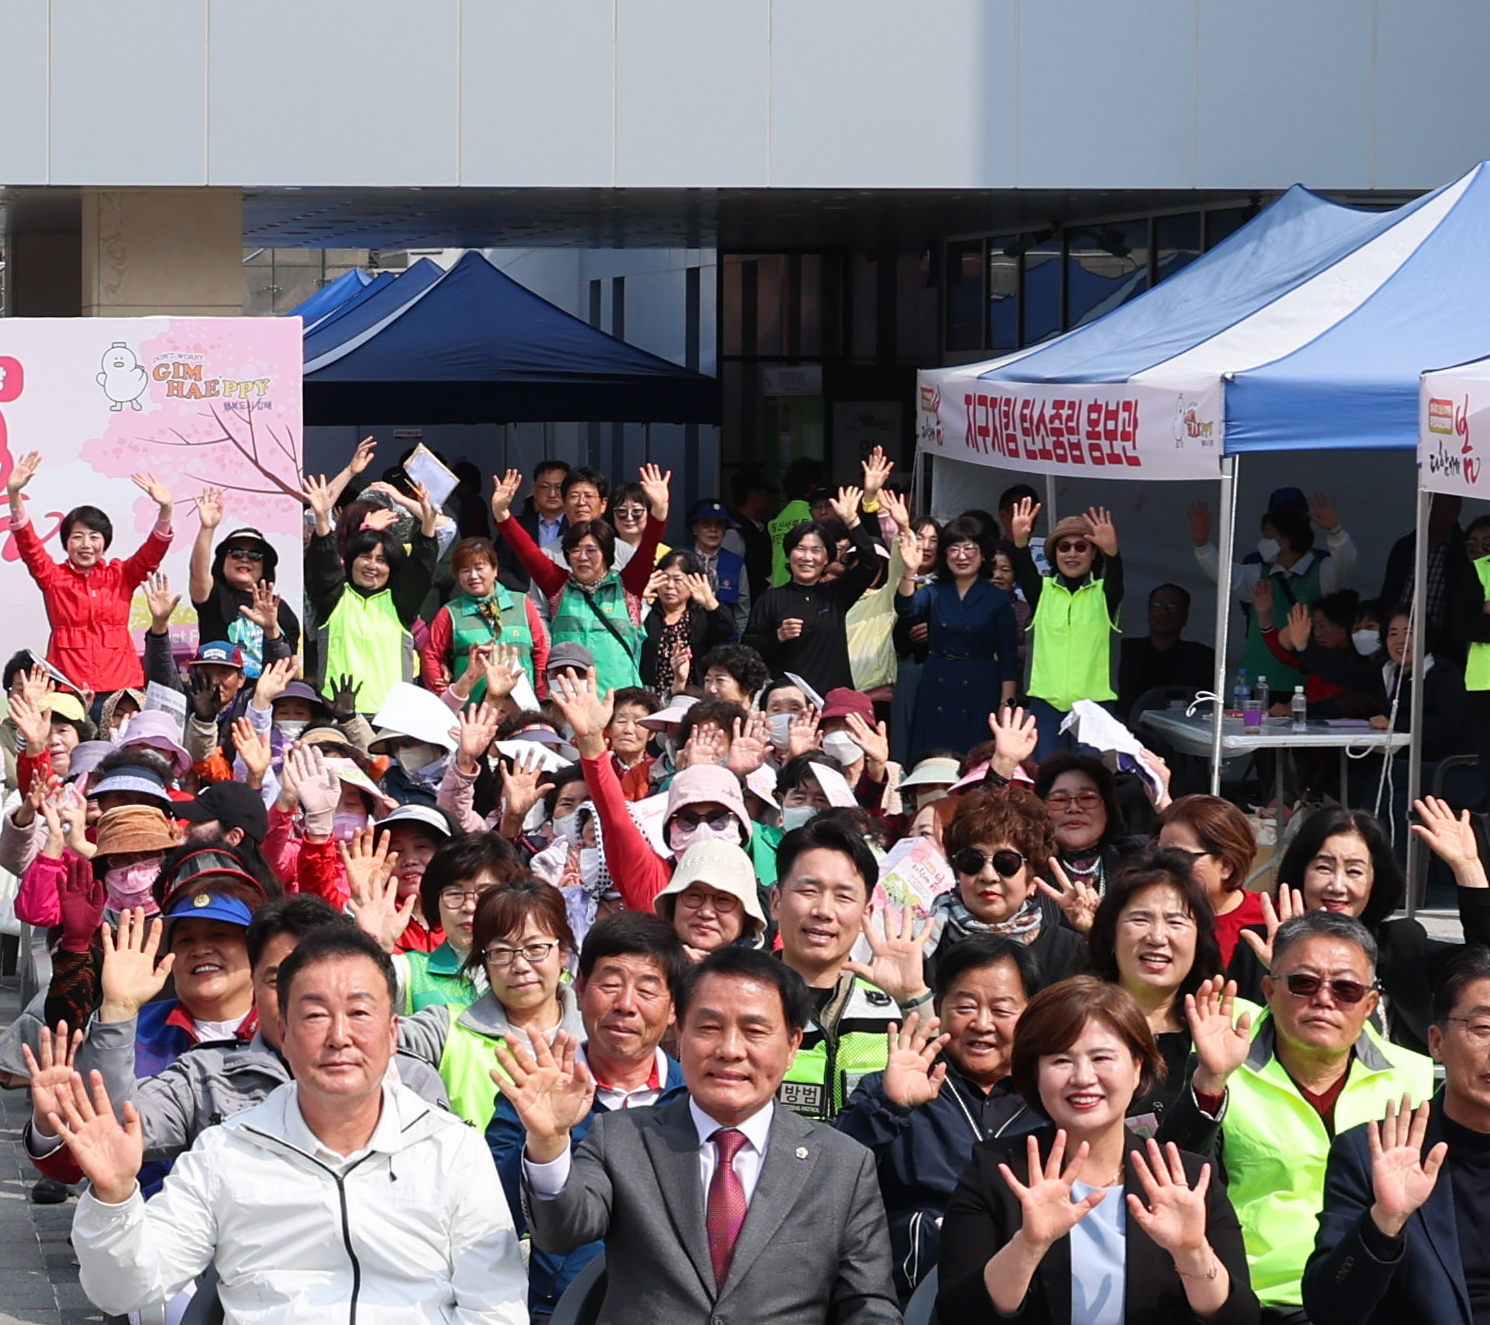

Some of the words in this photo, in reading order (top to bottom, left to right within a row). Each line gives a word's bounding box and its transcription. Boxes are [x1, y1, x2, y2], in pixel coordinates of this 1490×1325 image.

[152, 361, 204, 382] GIM
[964, 393, 1020, 459] 지구지킴
[1020, 398, 1086, 464] 탄소중립
[1086, 398, 1142, 467] 홍보관
[784, 1085, 817, 1105] 방범
